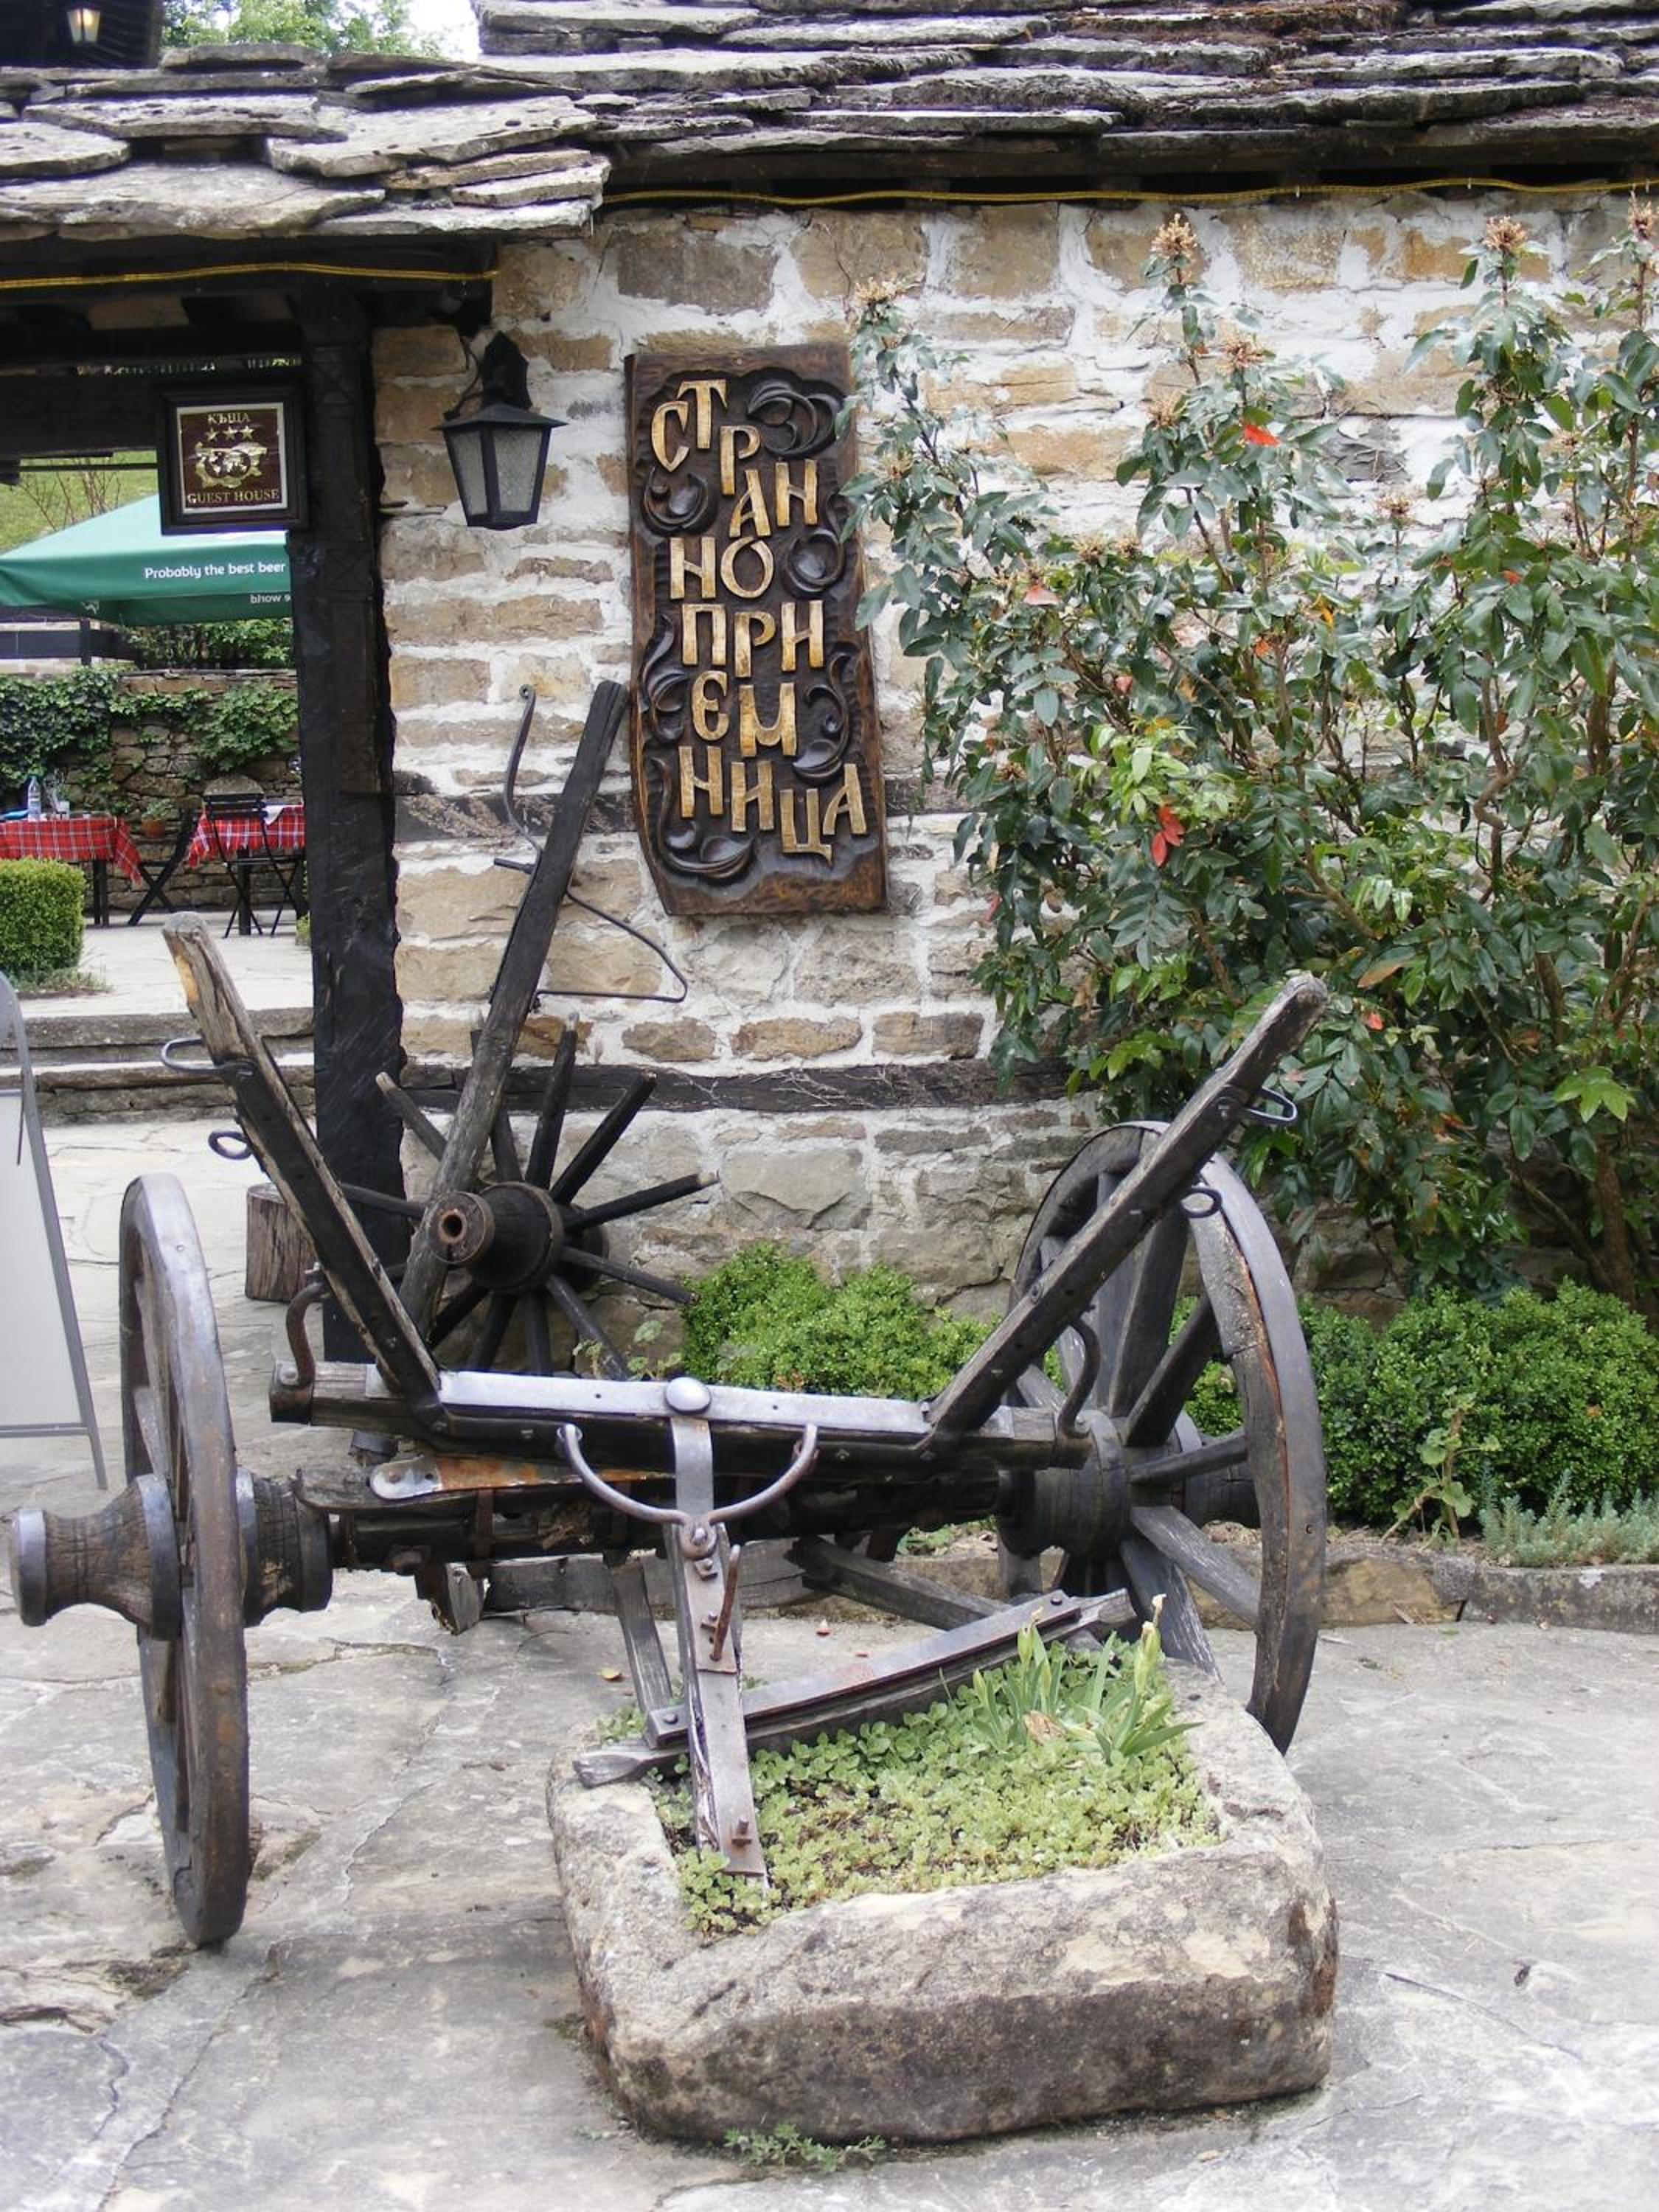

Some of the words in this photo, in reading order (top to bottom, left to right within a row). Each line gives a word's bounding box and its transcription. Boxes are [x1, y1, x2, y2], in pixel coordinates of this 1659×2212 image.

[187, 492, 232, 504] GUEST
[234, 489, 279, 502] HOUSE
[145, 566, 201, 579] Probably
[204, 564, 225, 576] the
[228, 563, 255, 574] best
[258, 562, 286, 573] beer
